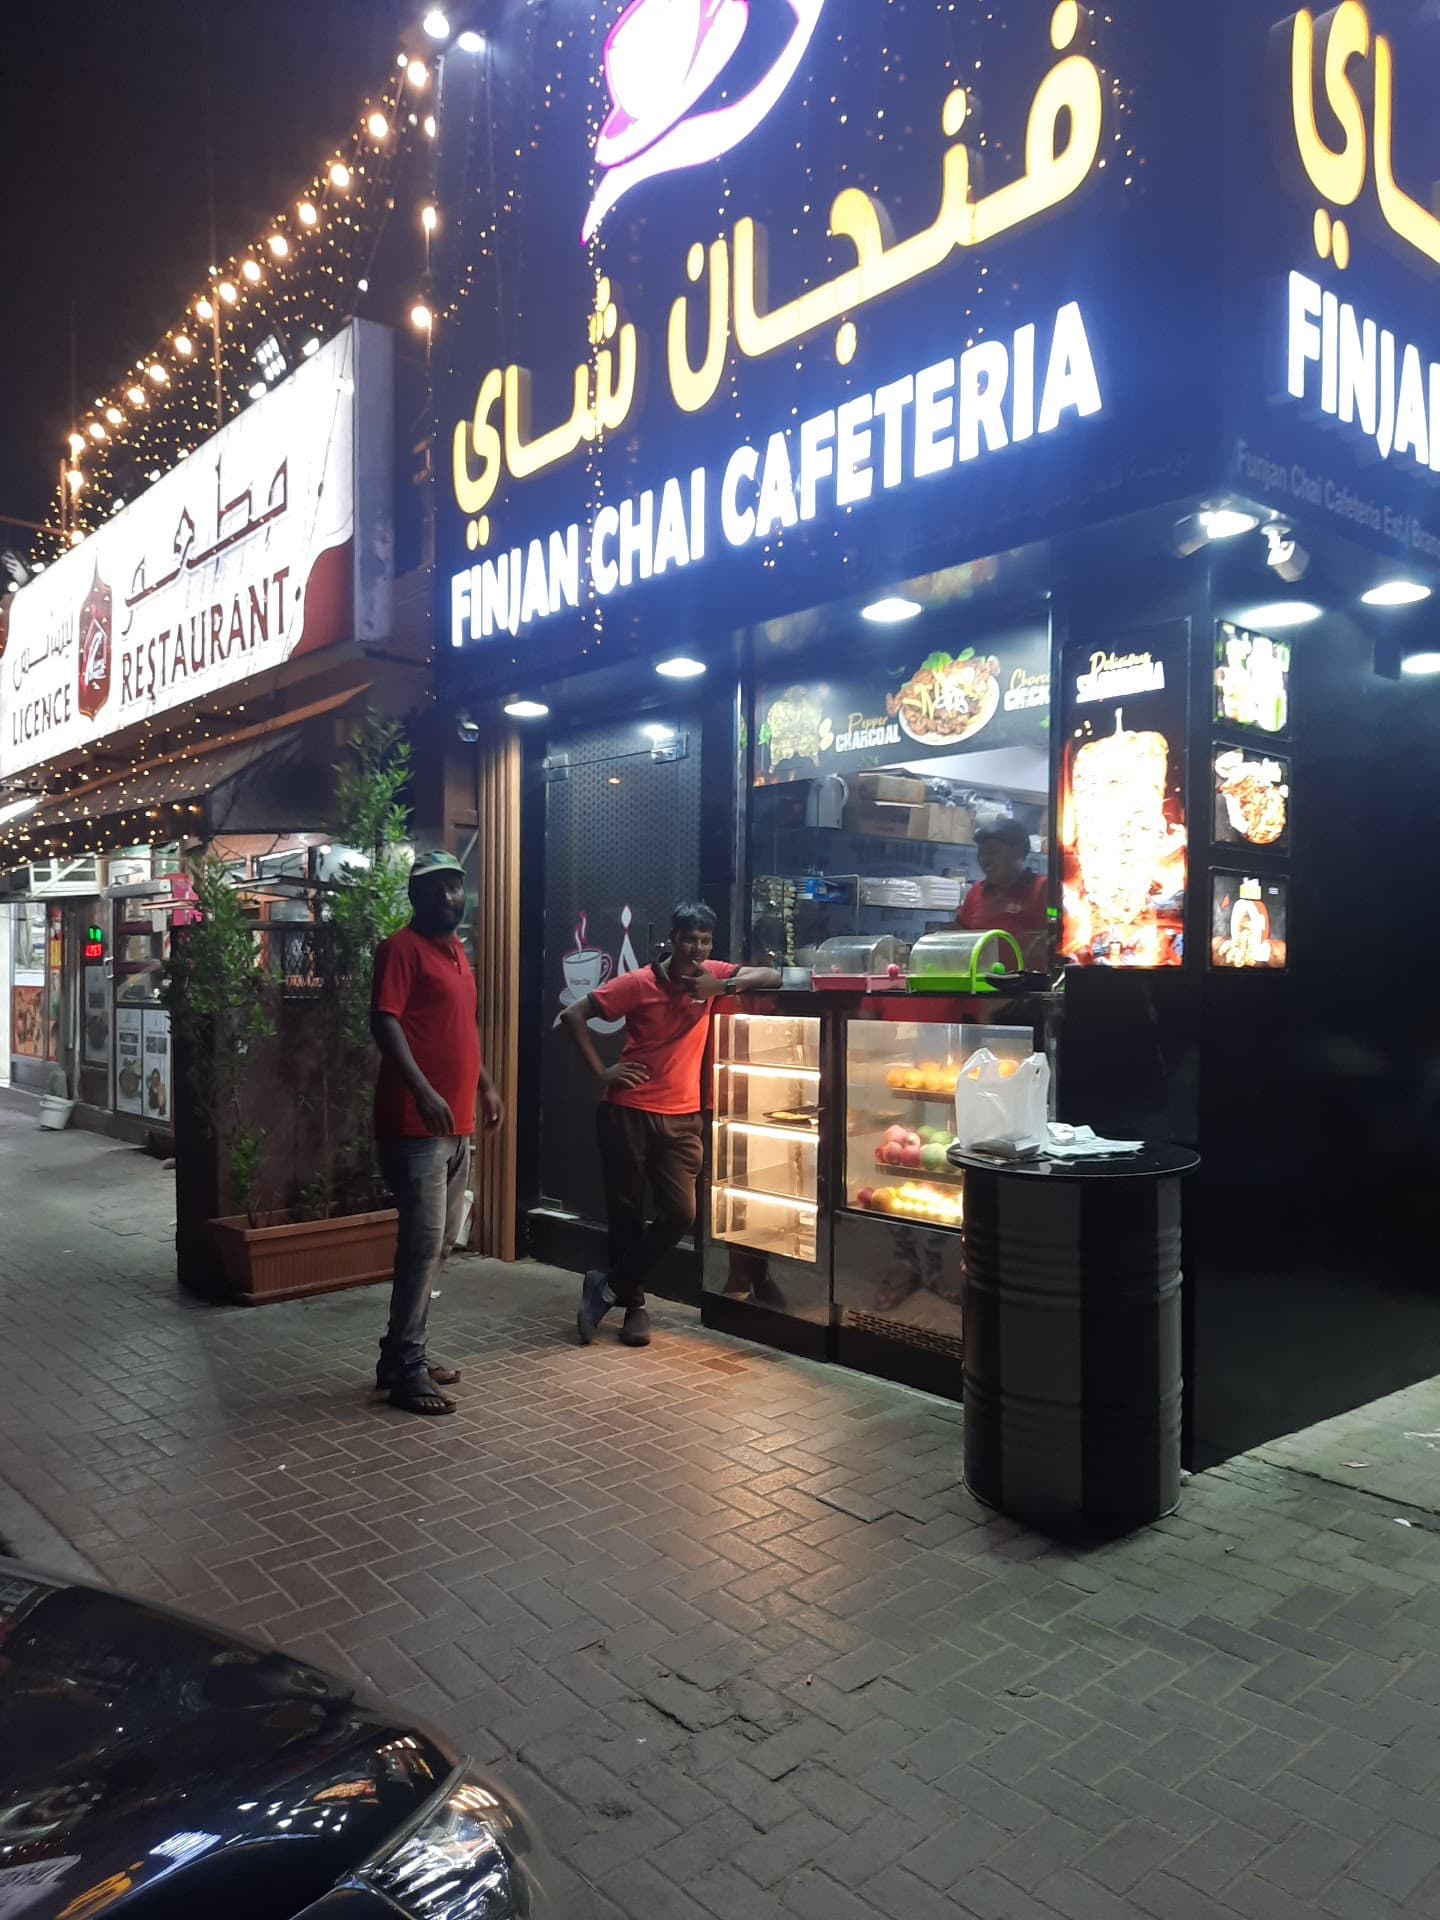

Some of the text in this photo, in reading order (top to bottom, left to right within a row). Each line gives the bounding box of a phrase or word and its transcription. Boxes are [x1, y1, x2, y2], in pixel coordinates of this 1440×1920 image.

[1292, 0, 1440, 269] اي
[453, 0, 1102, 550] فنجان شاي
[451, 523, 579, 647] FINJAN
[590, 466, 706, 594] CHAI
[720, 301, 1103, 547] CAFETERIA
[12, 683, 72, 746] LICENCE
[121, 565, 290, 706] RESTAURANT
[835, 723, 901, 752] CHARCOAL
